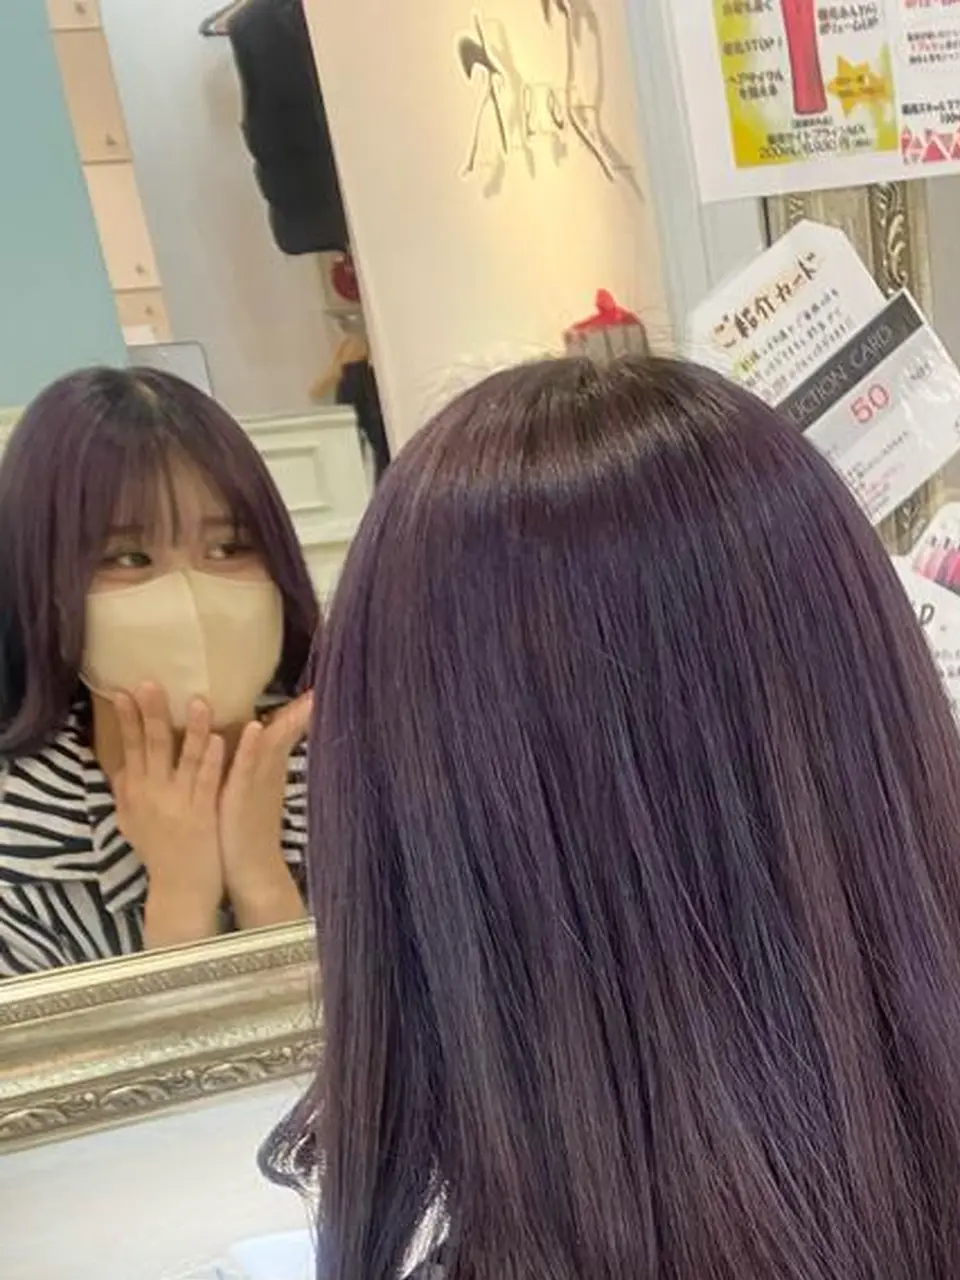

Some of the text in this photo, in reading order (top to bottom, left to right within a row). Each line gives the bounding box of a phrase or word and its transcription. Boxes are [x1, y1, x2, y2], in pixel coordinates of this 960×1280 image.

[713, 251, 818, 349] ご紹介カード
[849, 323, 894, 369] CARD
[850, 383, 890, 423] 50
